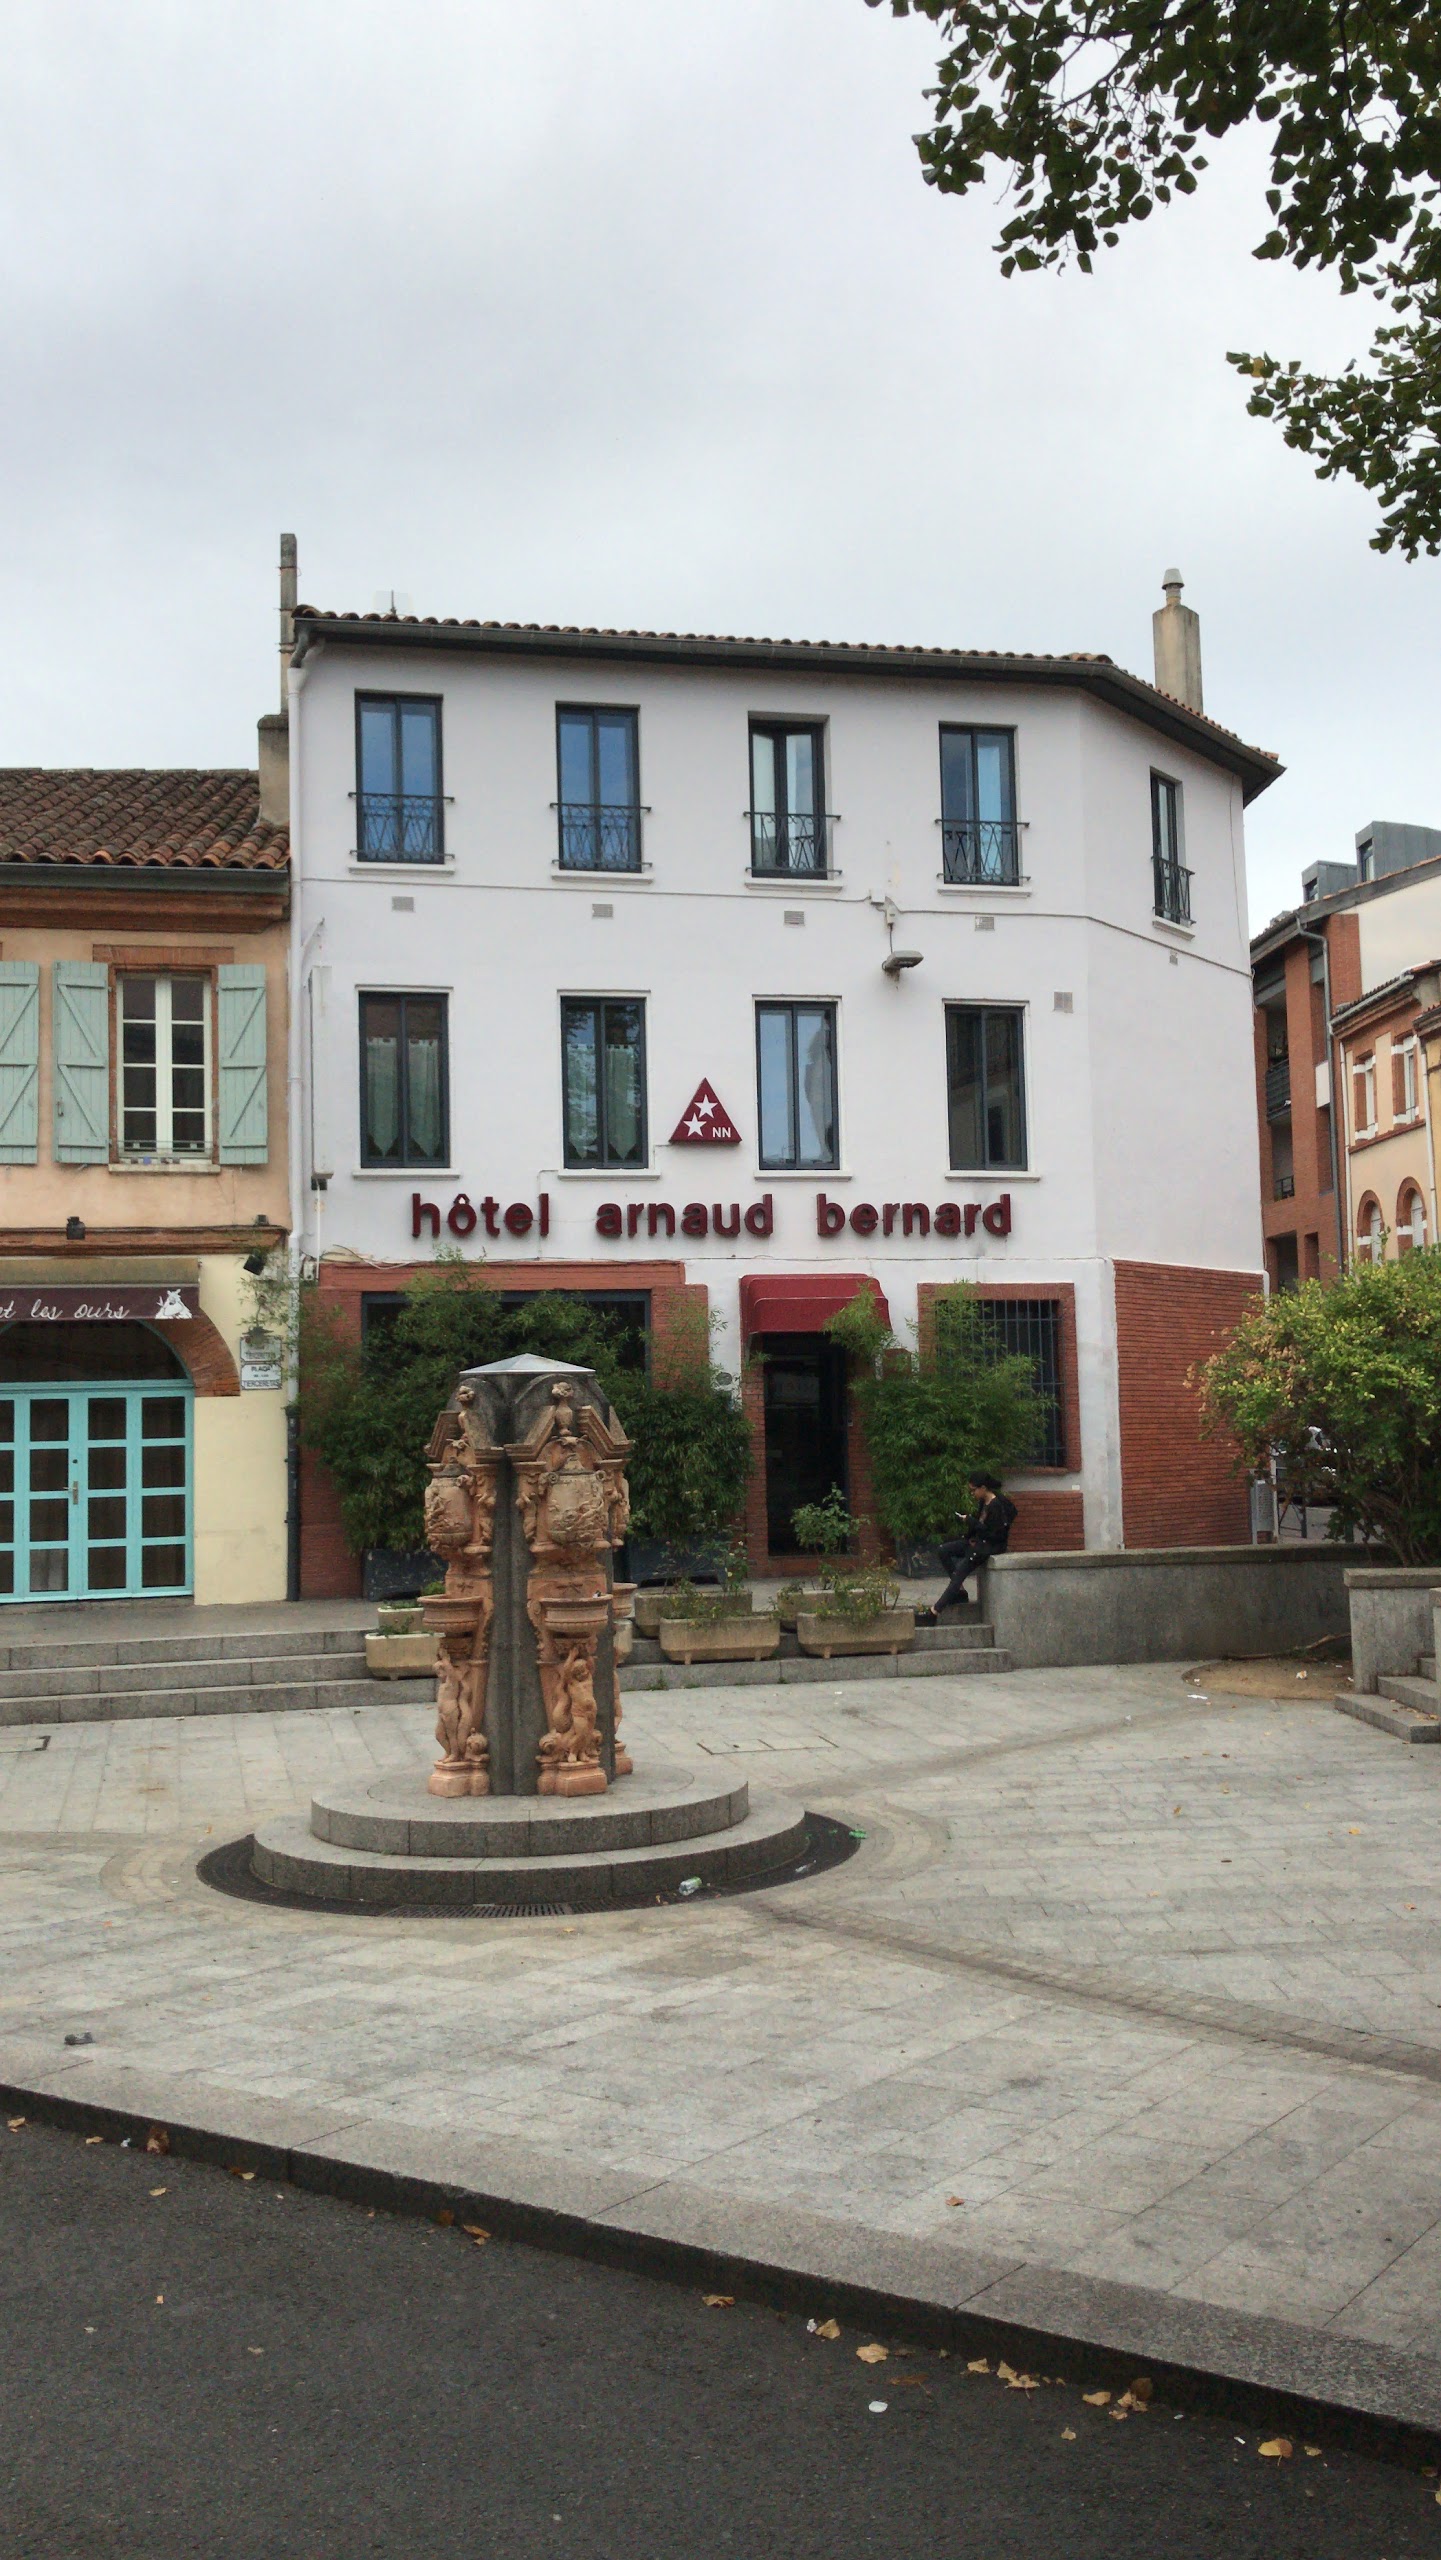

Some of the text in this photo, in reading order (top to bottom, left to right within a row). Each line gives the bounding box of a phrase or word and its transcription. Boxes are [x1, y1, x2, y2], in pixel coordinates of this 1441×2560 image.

[712, 1126, 732, 1138] NN
[411, 1193, 1012, 1239] hôtel arnaud bernard
[31, 1298, 63, 1320] les
[74, 1302, 130, 1319] ours
